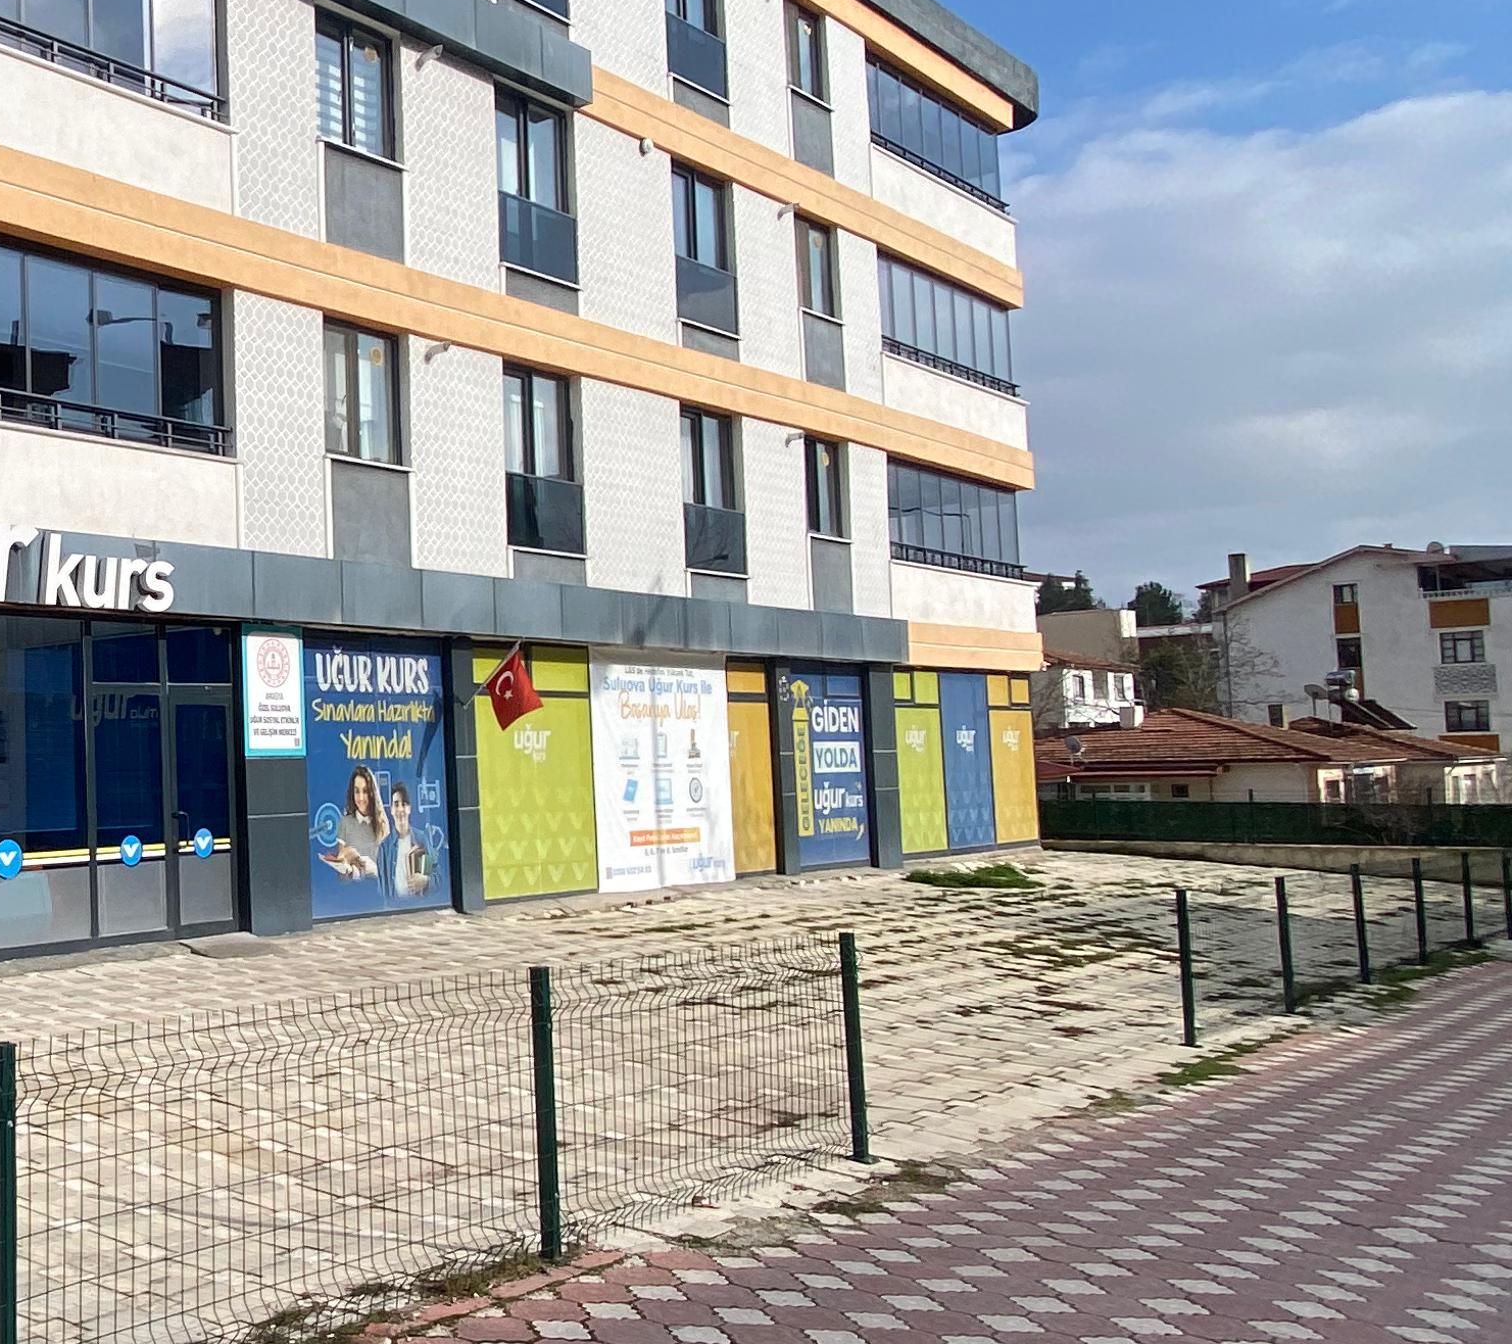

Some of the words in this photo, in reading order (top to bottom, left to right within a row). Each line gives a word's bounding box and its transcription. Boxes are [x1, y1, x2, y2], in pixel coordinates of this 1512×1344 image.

[42, 529, 175, 613] kurs
[315, 645, 373, 692] UĞUR
[376, 656, 429, 694] KURS
[676, 679, 698, 694] Kurs
[311, 698, 375, 722] Sınavlara
[811, 699, 860, 733] GİDEN
[339, 728, 412, 759] Yanında!
[514, 723, 551, 754] uğur
[815, 747, 858, 769] YOLDA
[814, 781, 846, 815] uğur
